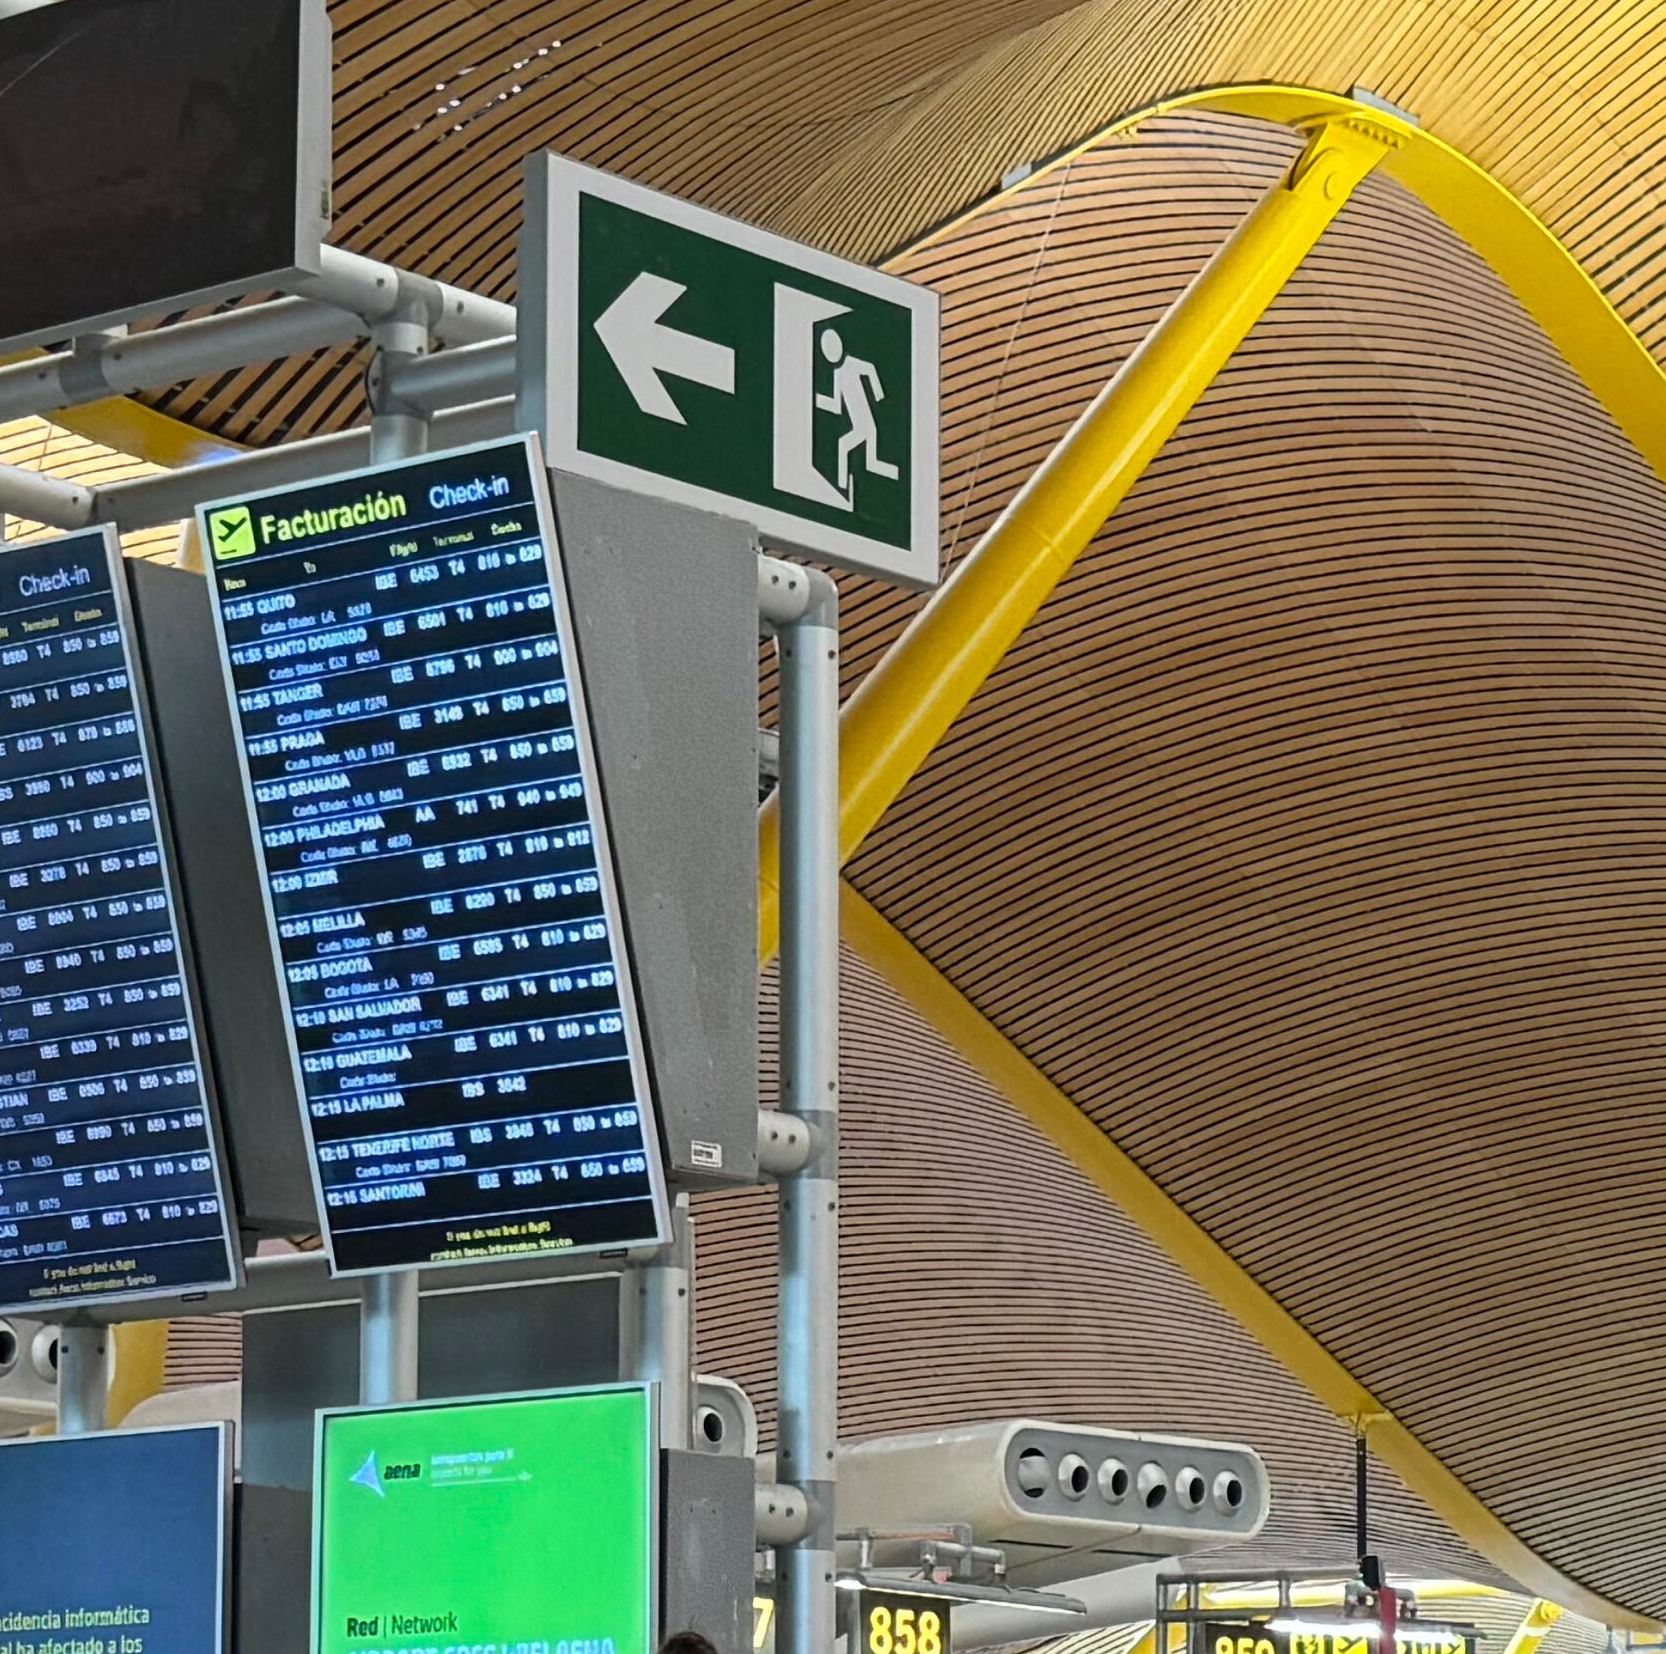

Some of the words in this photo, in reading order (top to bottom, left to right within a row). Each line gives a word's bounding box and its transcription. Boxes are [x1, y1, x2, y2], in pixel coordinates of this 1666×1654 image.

[260, 490, 407, 545] Facturación
[429, 475, 510, 509] Check-in
[19, 566, 90, 597] Check-in
[384, 1463, 421, 1480] aena
[65, 1604, 150, 1629] informática
[347, 1616, 378, 1637] Red
[391, 1611, 458, 1635] Network
[107, 1640, 117, 1654] a
[121, 1635, 143, 1654] los
